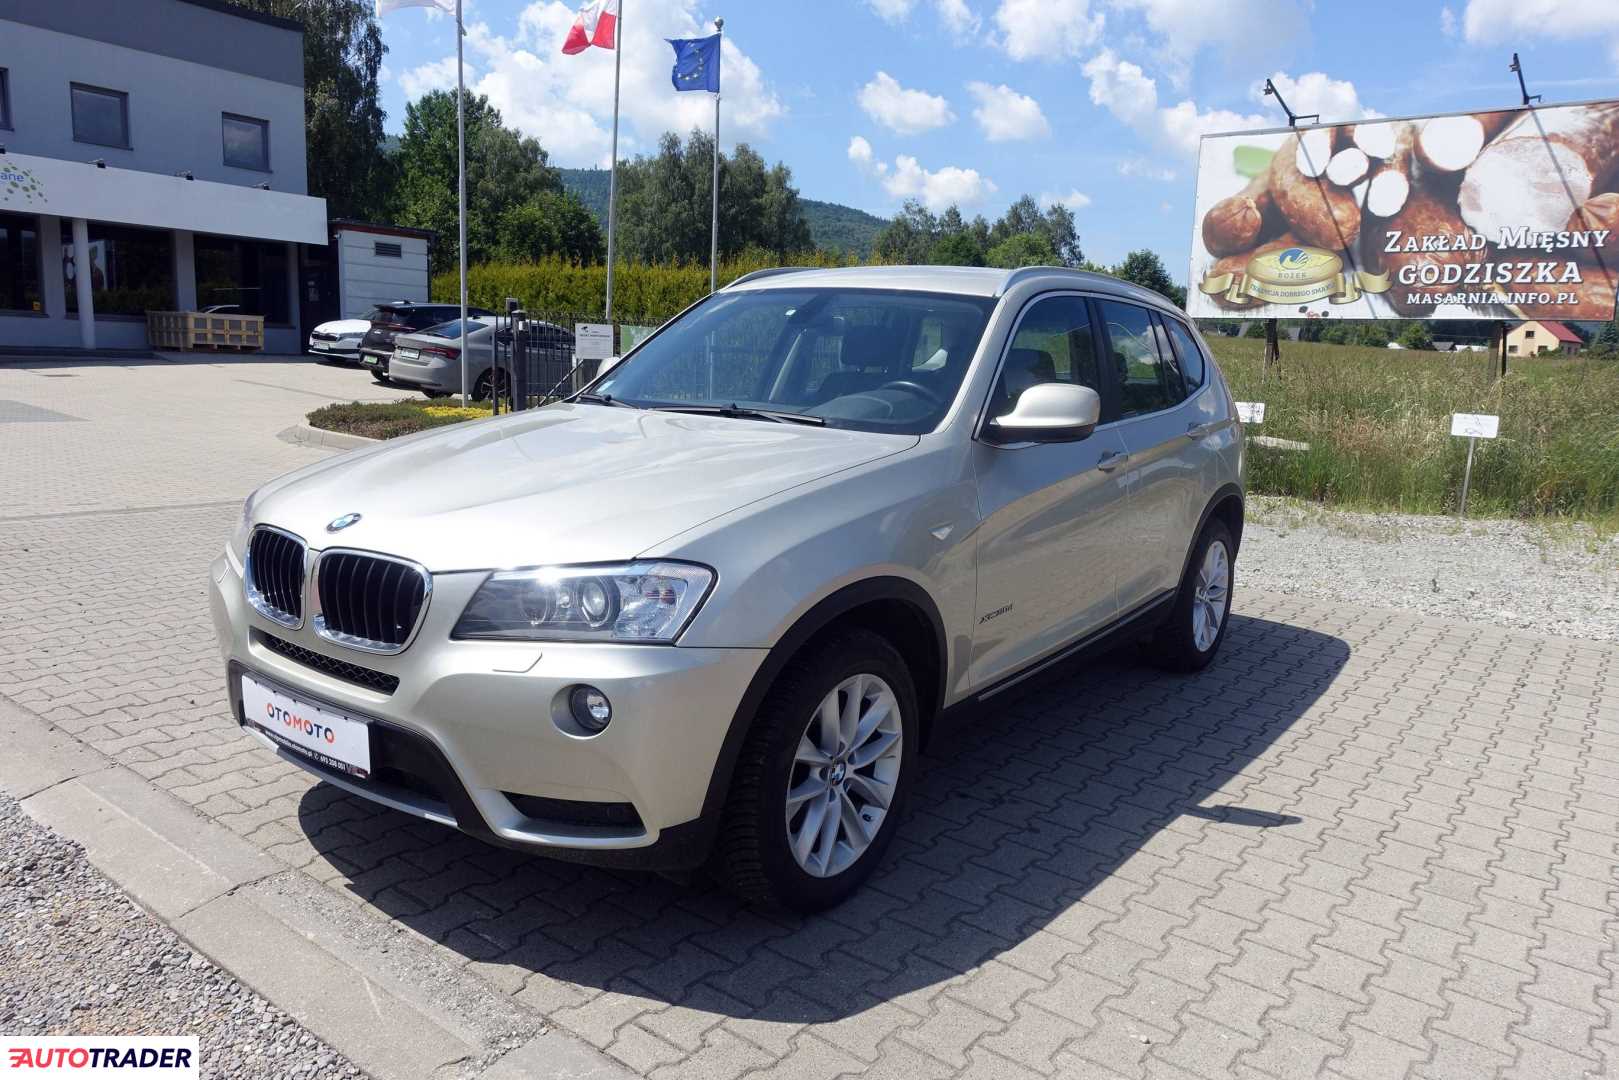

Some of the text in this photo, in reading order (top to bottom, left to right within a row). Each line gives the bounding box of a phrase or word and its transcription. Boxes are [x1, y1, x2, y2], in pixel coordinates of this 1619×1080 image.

[1398, 261, 1583, 285] GODZISZKA
[1406, 292, 1579, 305] MASARNIA.INFO.PL
[267, 703, 335, 744] OTOMOTO
